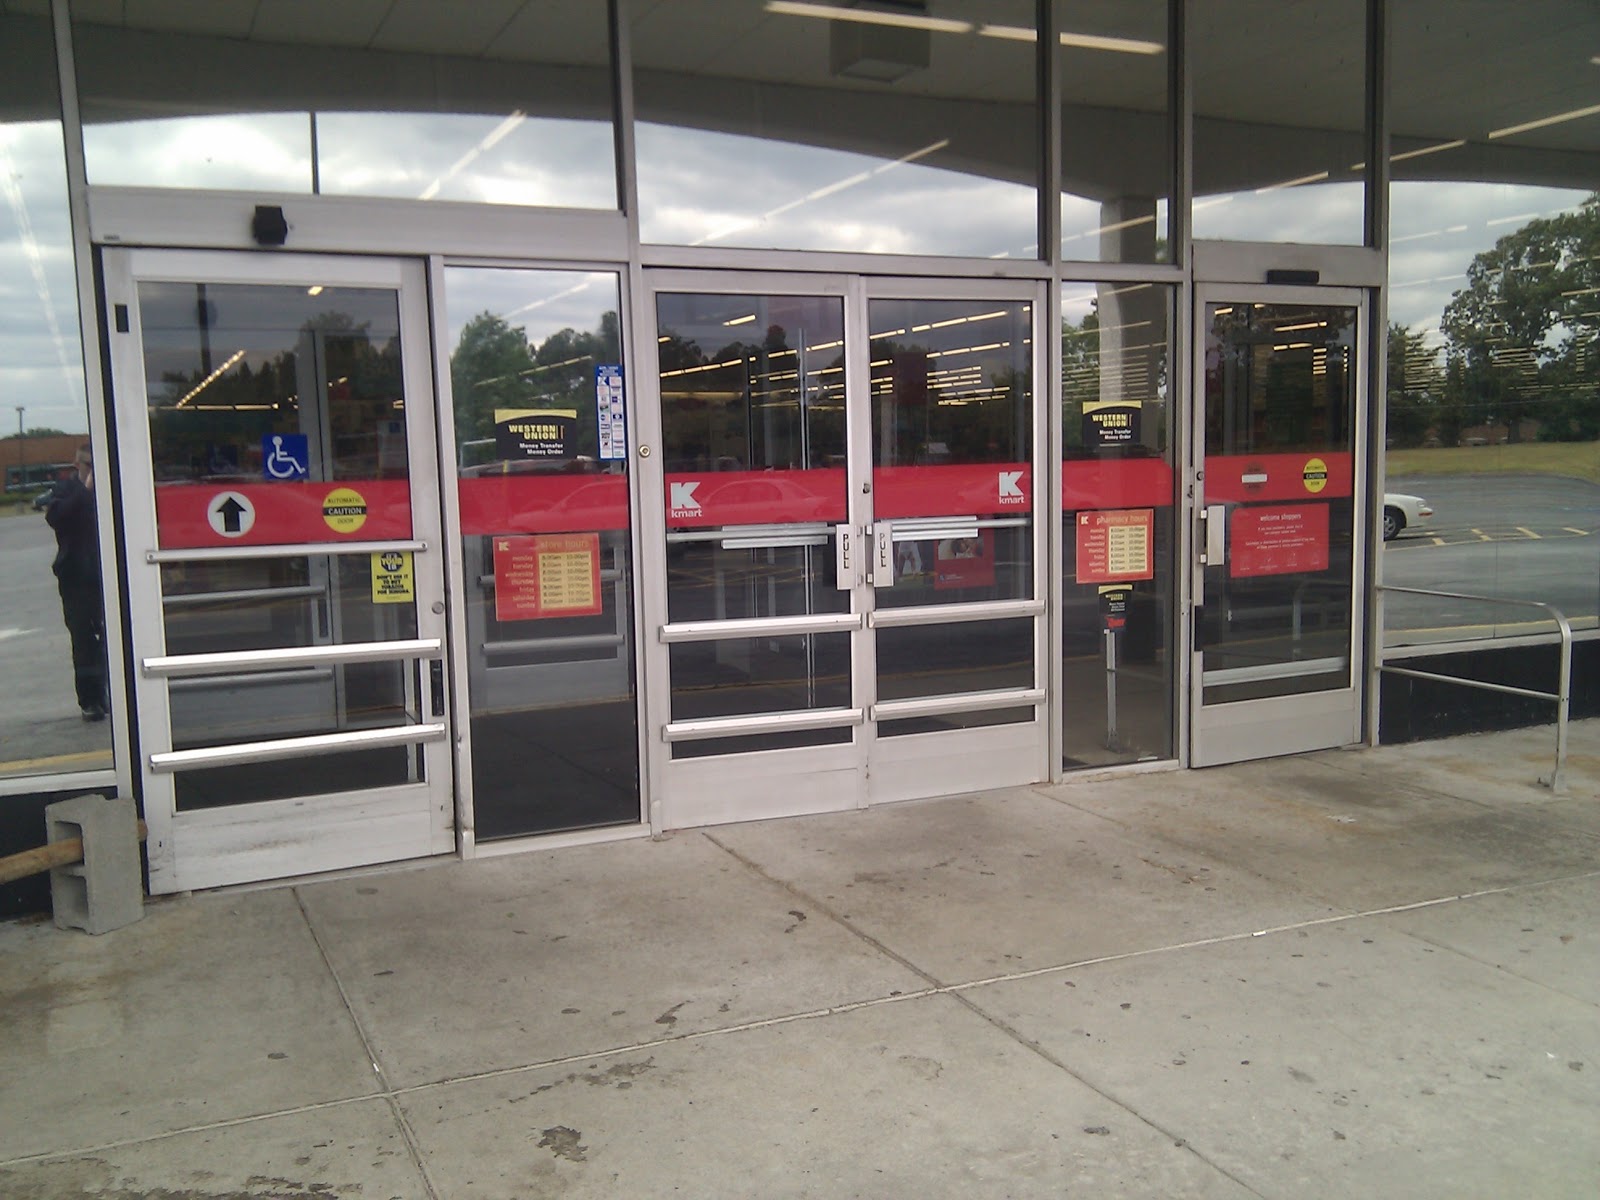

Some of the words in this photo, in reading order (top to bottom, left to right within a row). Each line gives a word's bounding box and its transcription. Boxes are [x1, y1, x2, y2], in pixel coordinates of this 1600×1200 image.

[508, 425, 556, 433] WESTERN
[523, 432, 556, 440] UNION
[999, 471, 1024, 496] K
[670, 482, 701, 509] K
[999, 496, 1024, 504] kmart
[328, 507, 362, 515] CAUTION
[671, 509, 702, 518] kmart
[842, 533, 850, 569] PULL
[879, 533, 887, 568] PULL
